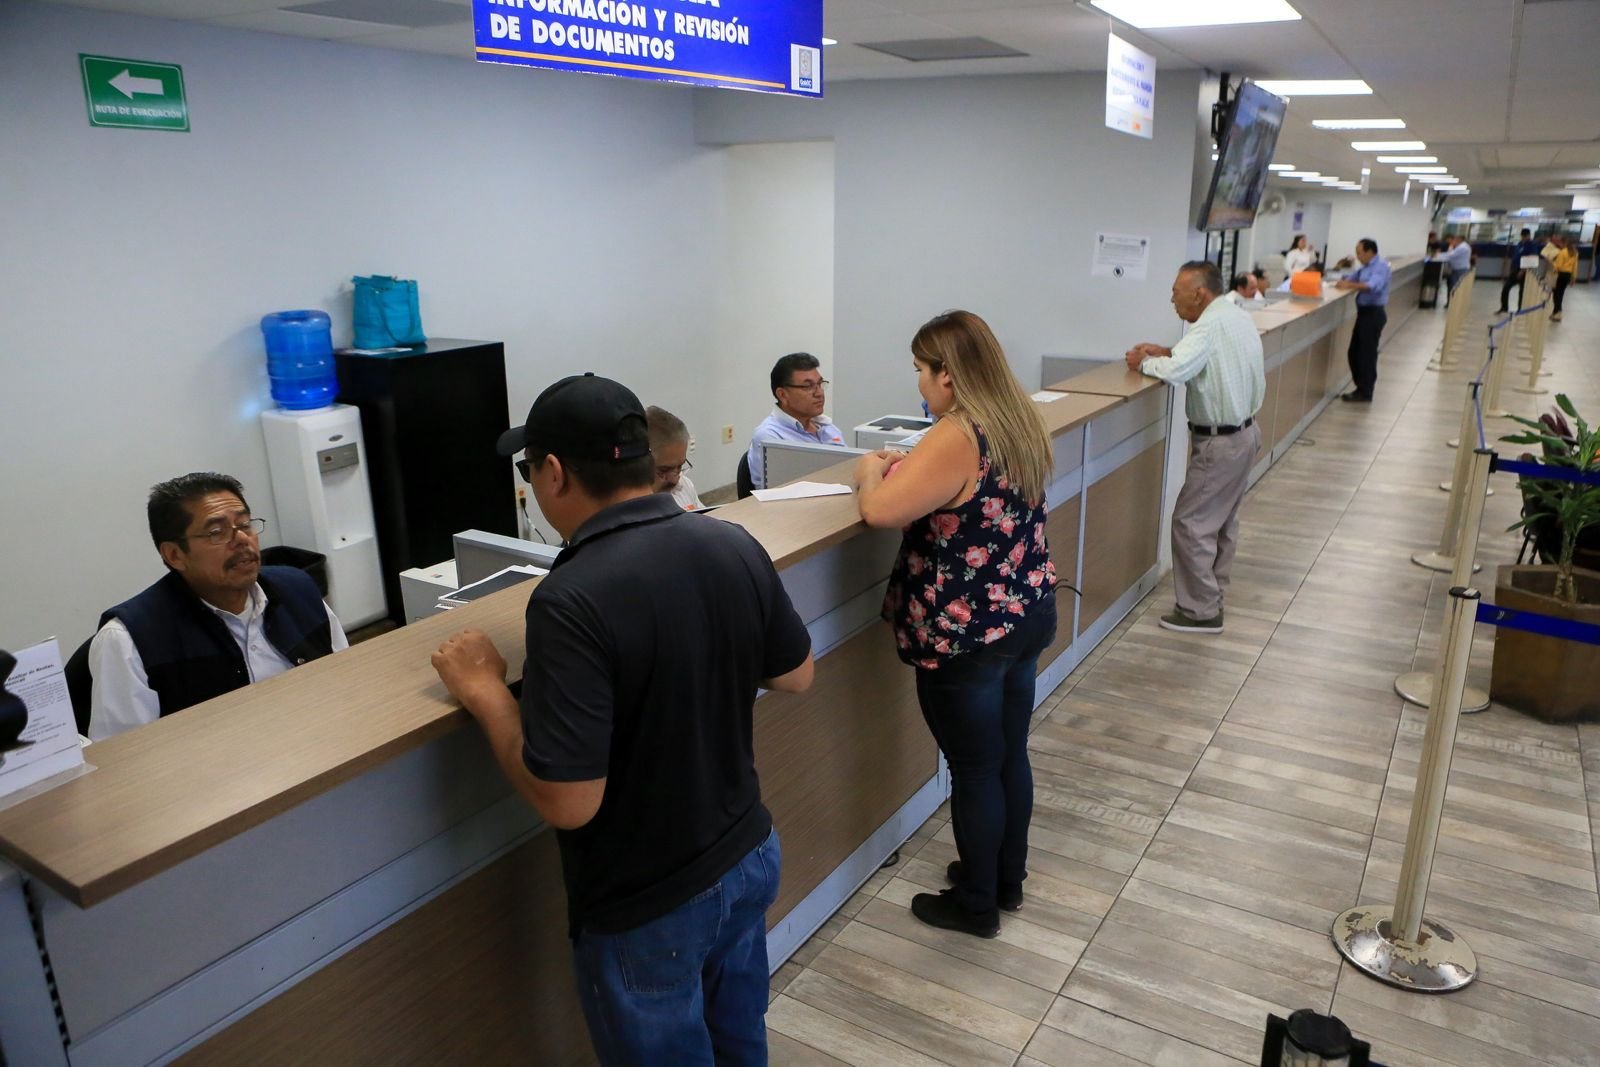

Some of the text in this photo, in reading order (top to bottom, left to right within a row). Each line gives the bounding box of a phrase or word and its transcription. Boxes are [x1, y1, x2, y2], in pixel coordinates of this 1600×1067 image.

[488, 0, 749, 46] RMACIÓN Y REVISIÓN
[490, 13, 675, 61] DE DOCUMENTOS
[95, 104, 118, 114] RUTA
[118, 106, 130, 115] DE
